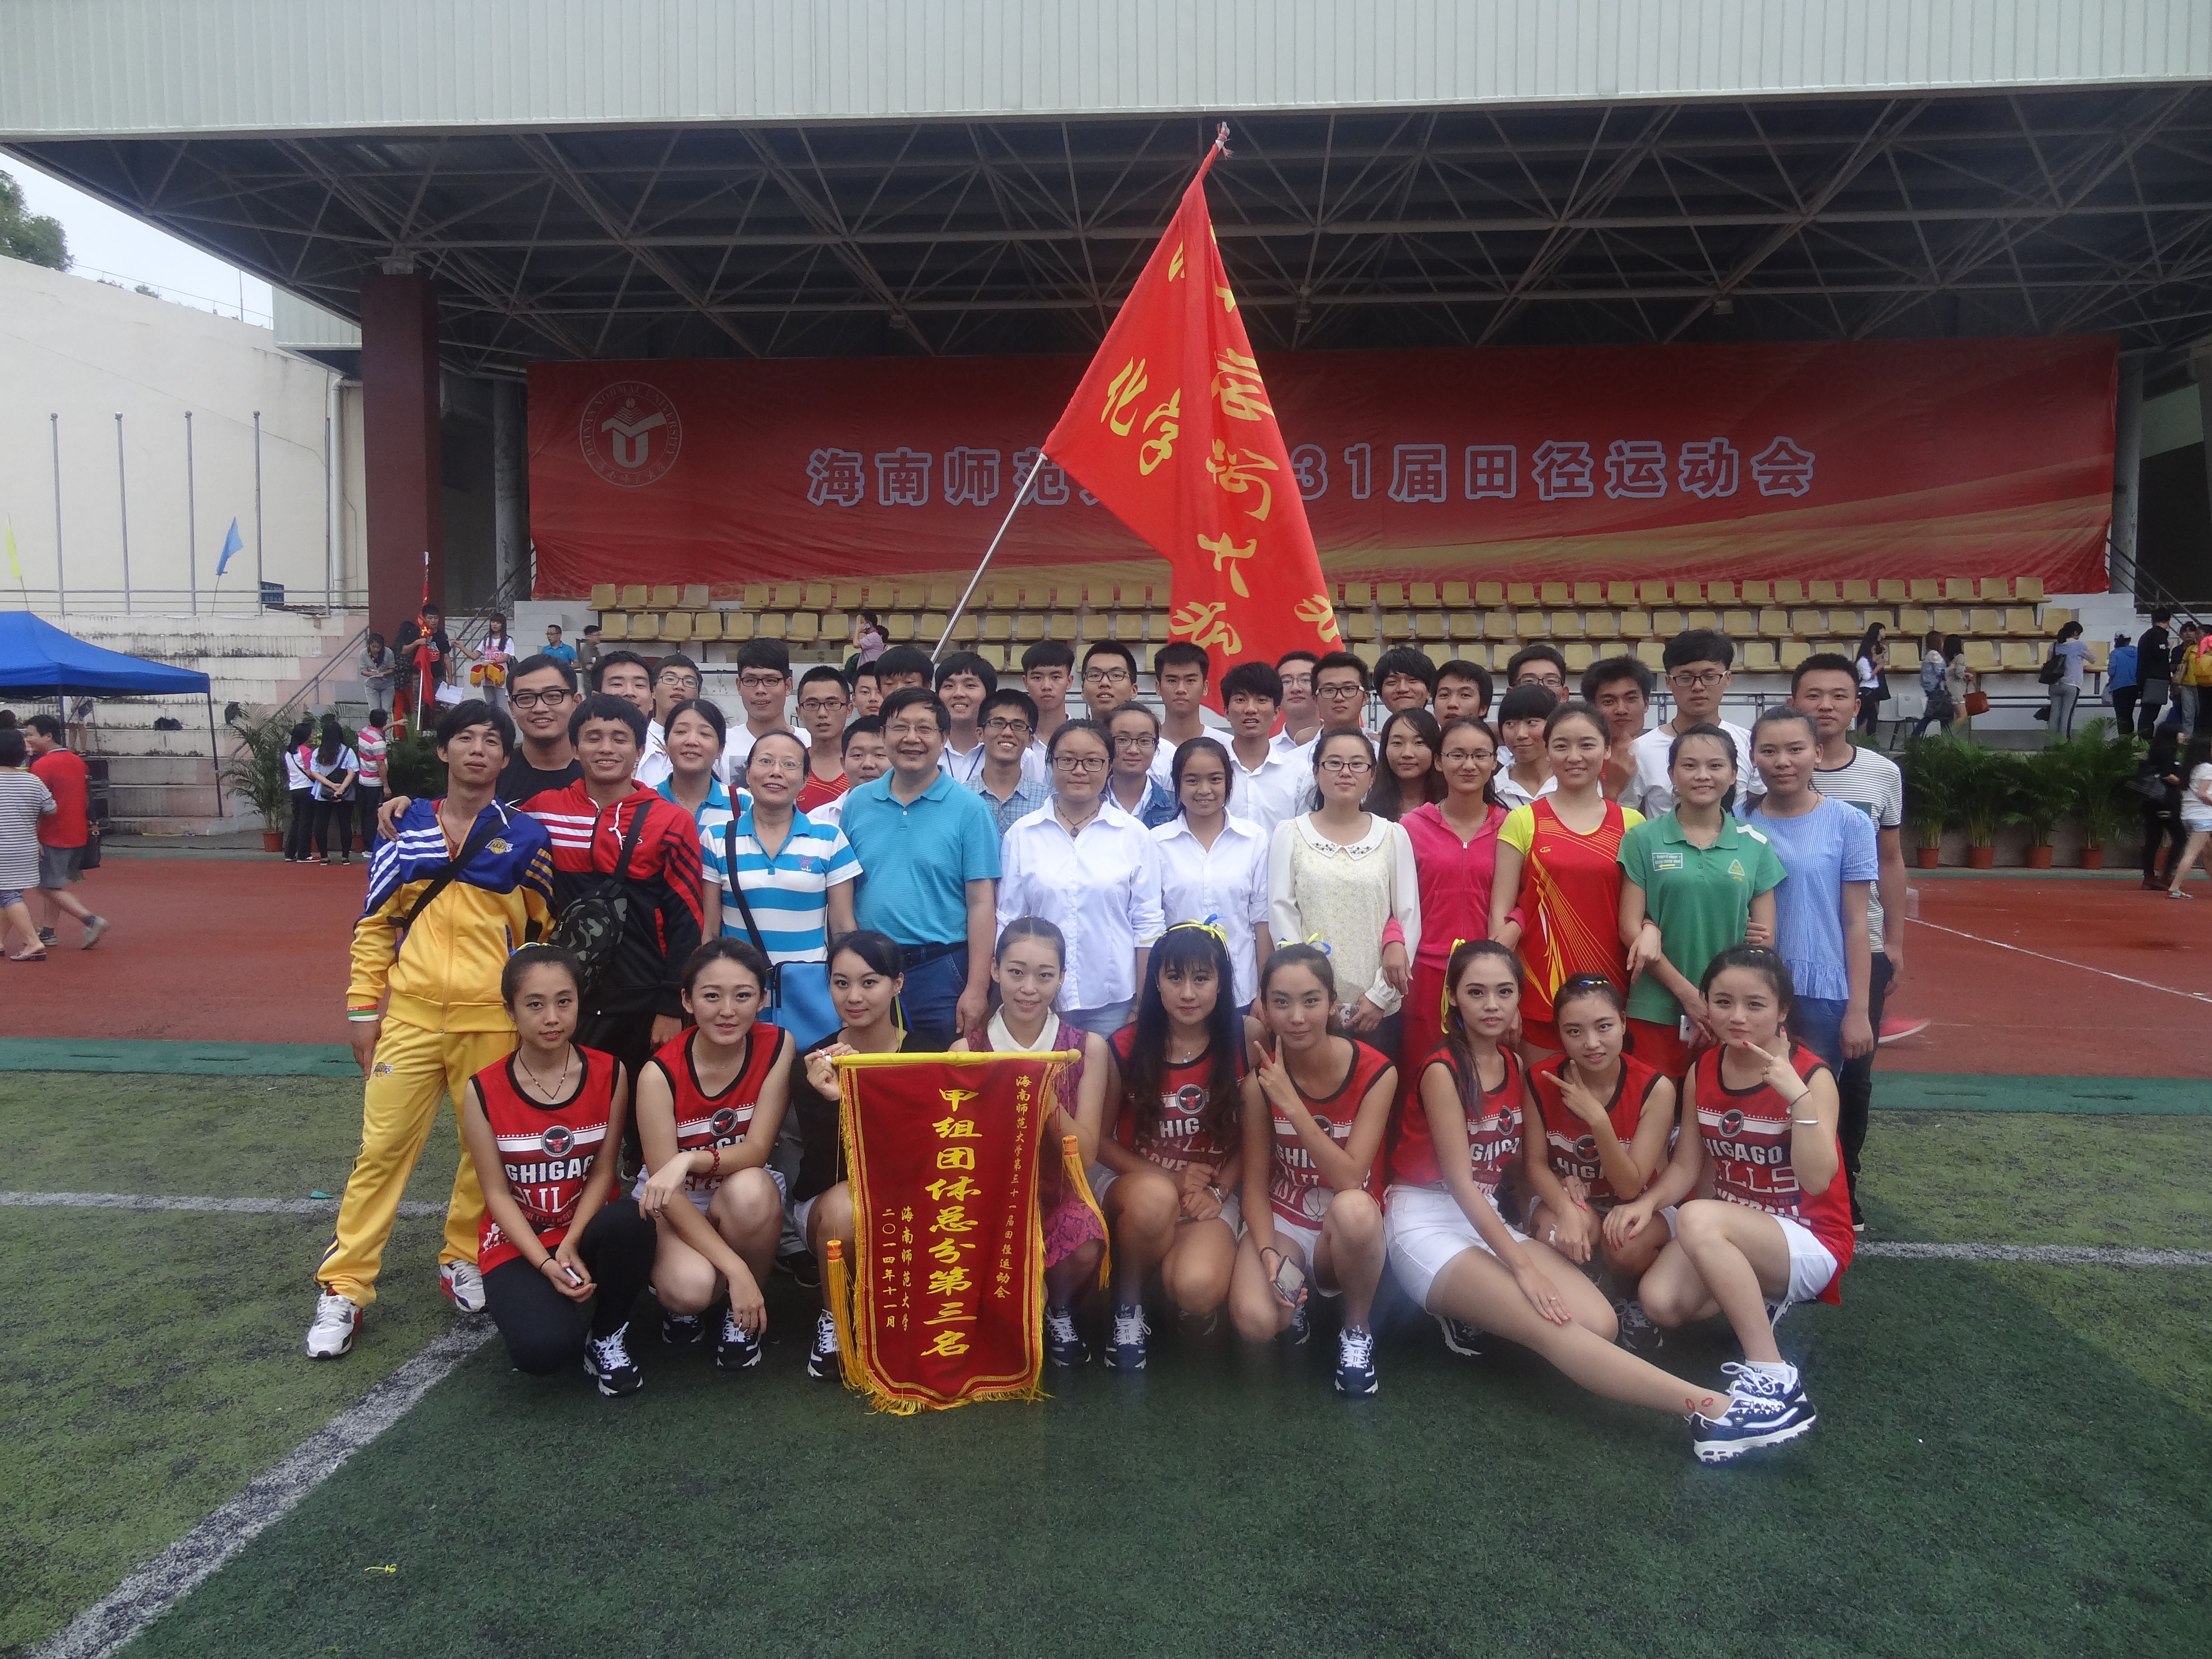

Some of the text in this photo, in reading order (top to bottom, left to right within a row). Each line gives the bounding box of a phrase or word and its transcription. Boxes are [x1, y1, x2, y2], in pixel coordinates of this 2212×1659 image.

[806, 446, 1099, 506] 海南师范
[901, 1205, 914, 1331] 海南师范大学
[920, 1088, 983, 1356] 甲组团体总分第三名
